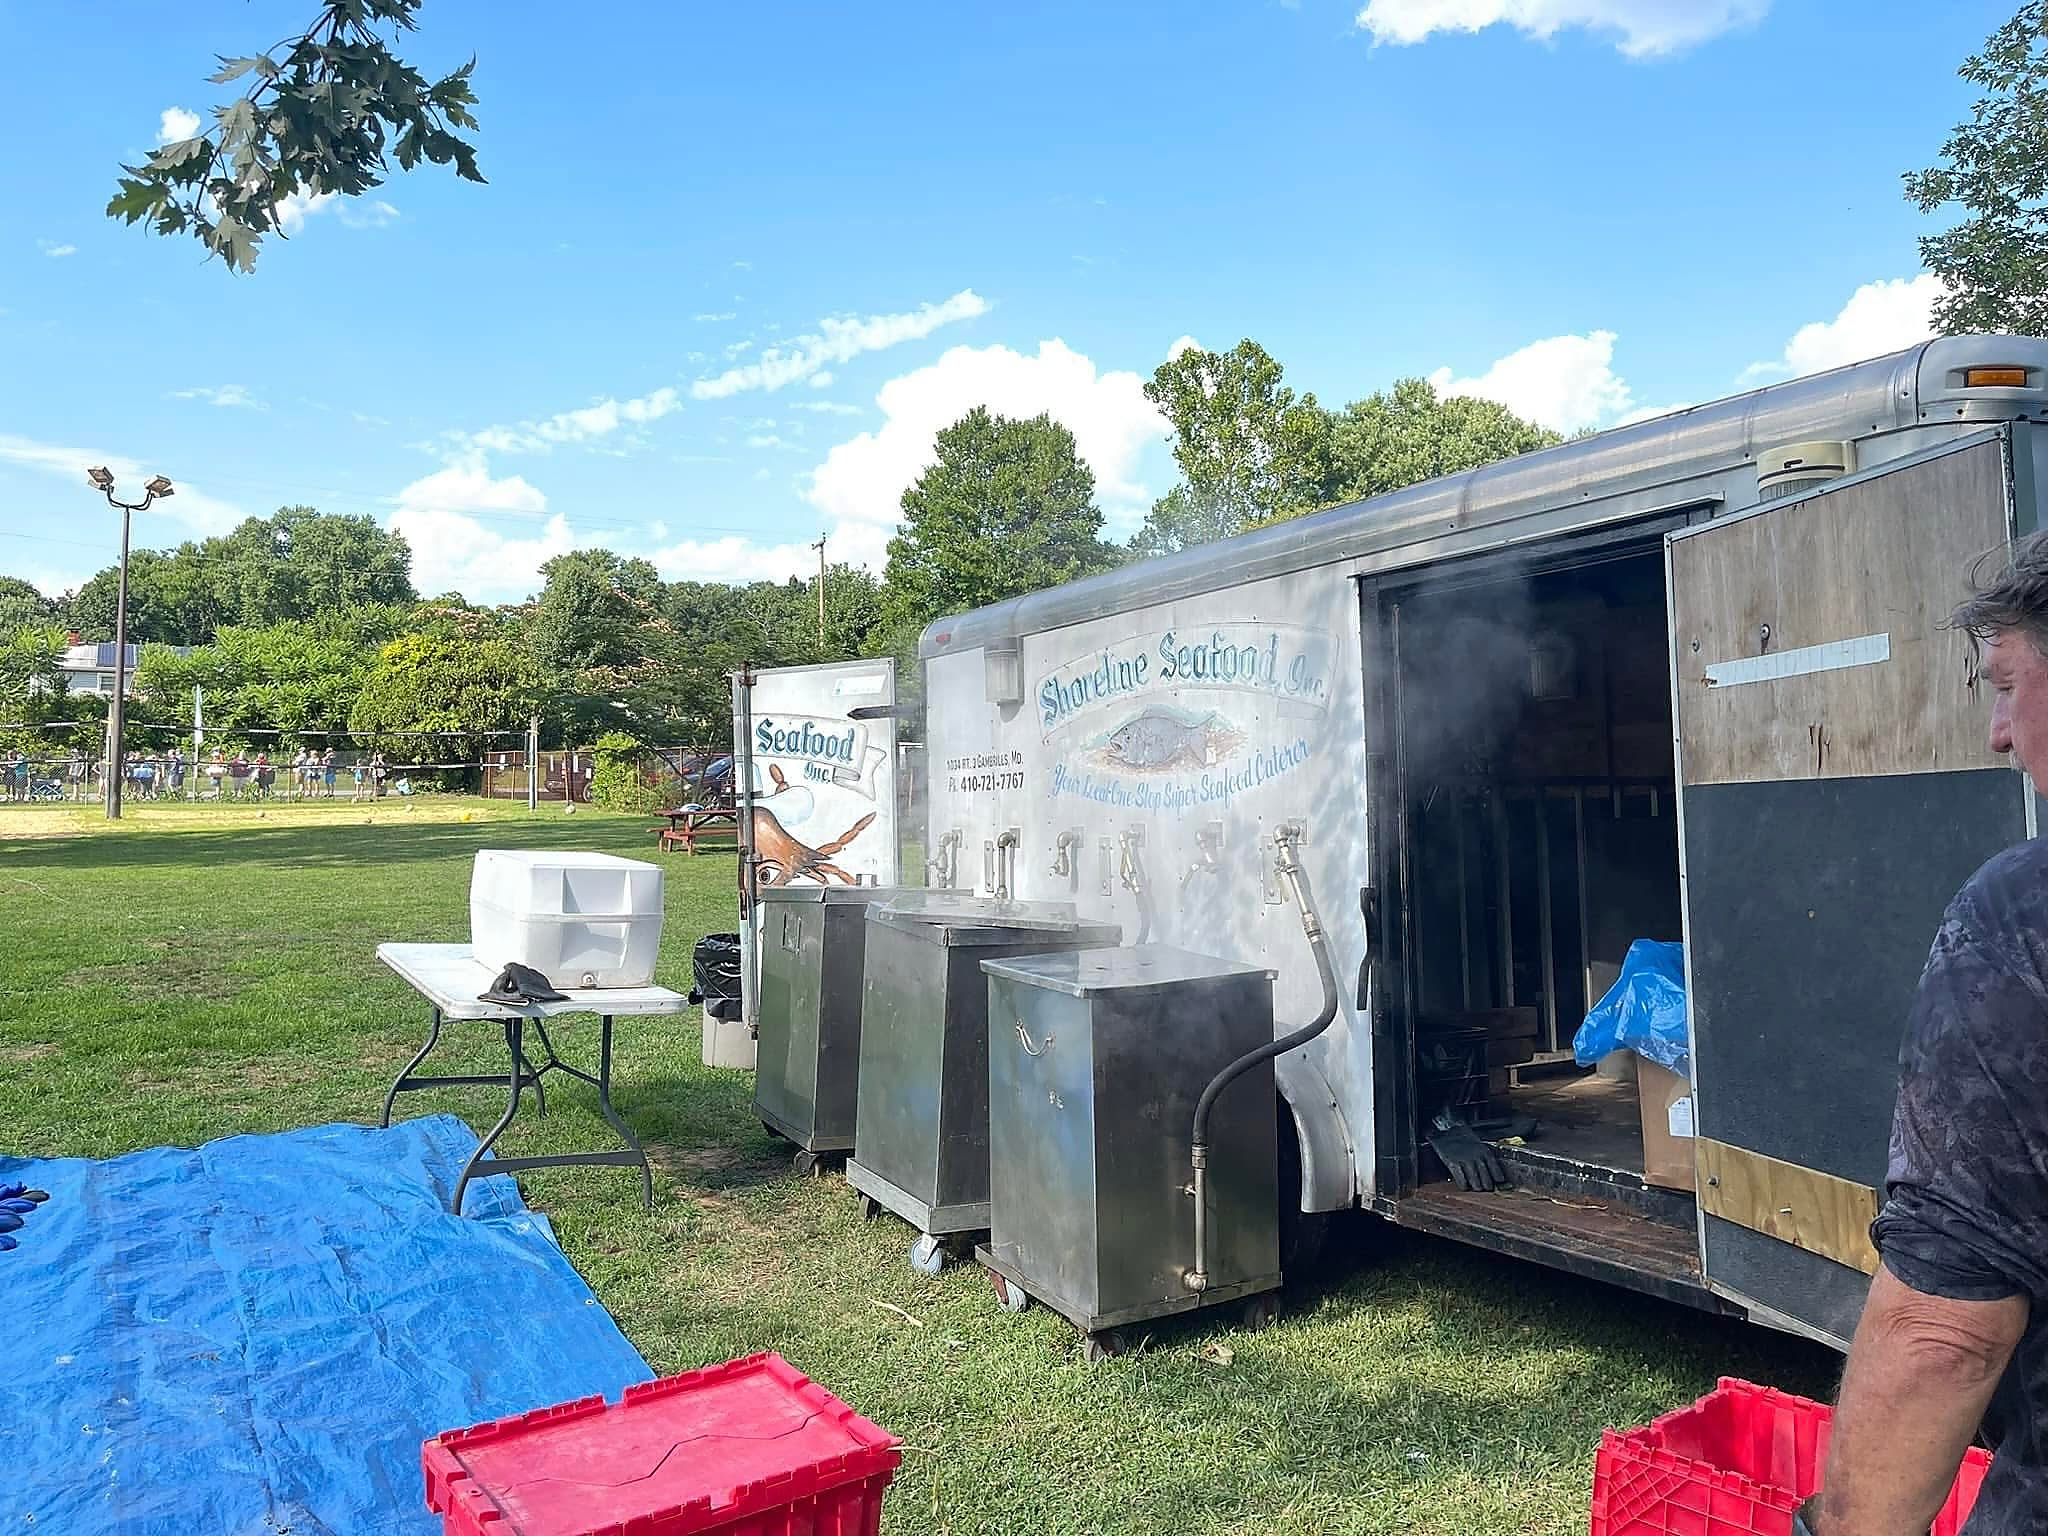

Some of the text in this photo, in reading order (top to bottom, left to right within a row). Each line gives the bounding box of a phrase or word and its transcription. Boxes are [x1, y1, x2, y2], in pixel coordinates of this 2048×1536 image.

[1040, 652, 1149, 727] Shoreline
[756, 718, 855, 764] Seafood
[804, 761, 830, 784] Inc.
[960, 771, 1024, 792] 410-721-7767
[1134, 781, 1161, 817] Stop
[1200, 757, 1253, 809] Seafood
[1255, 737, 1310, 786] Caterer
